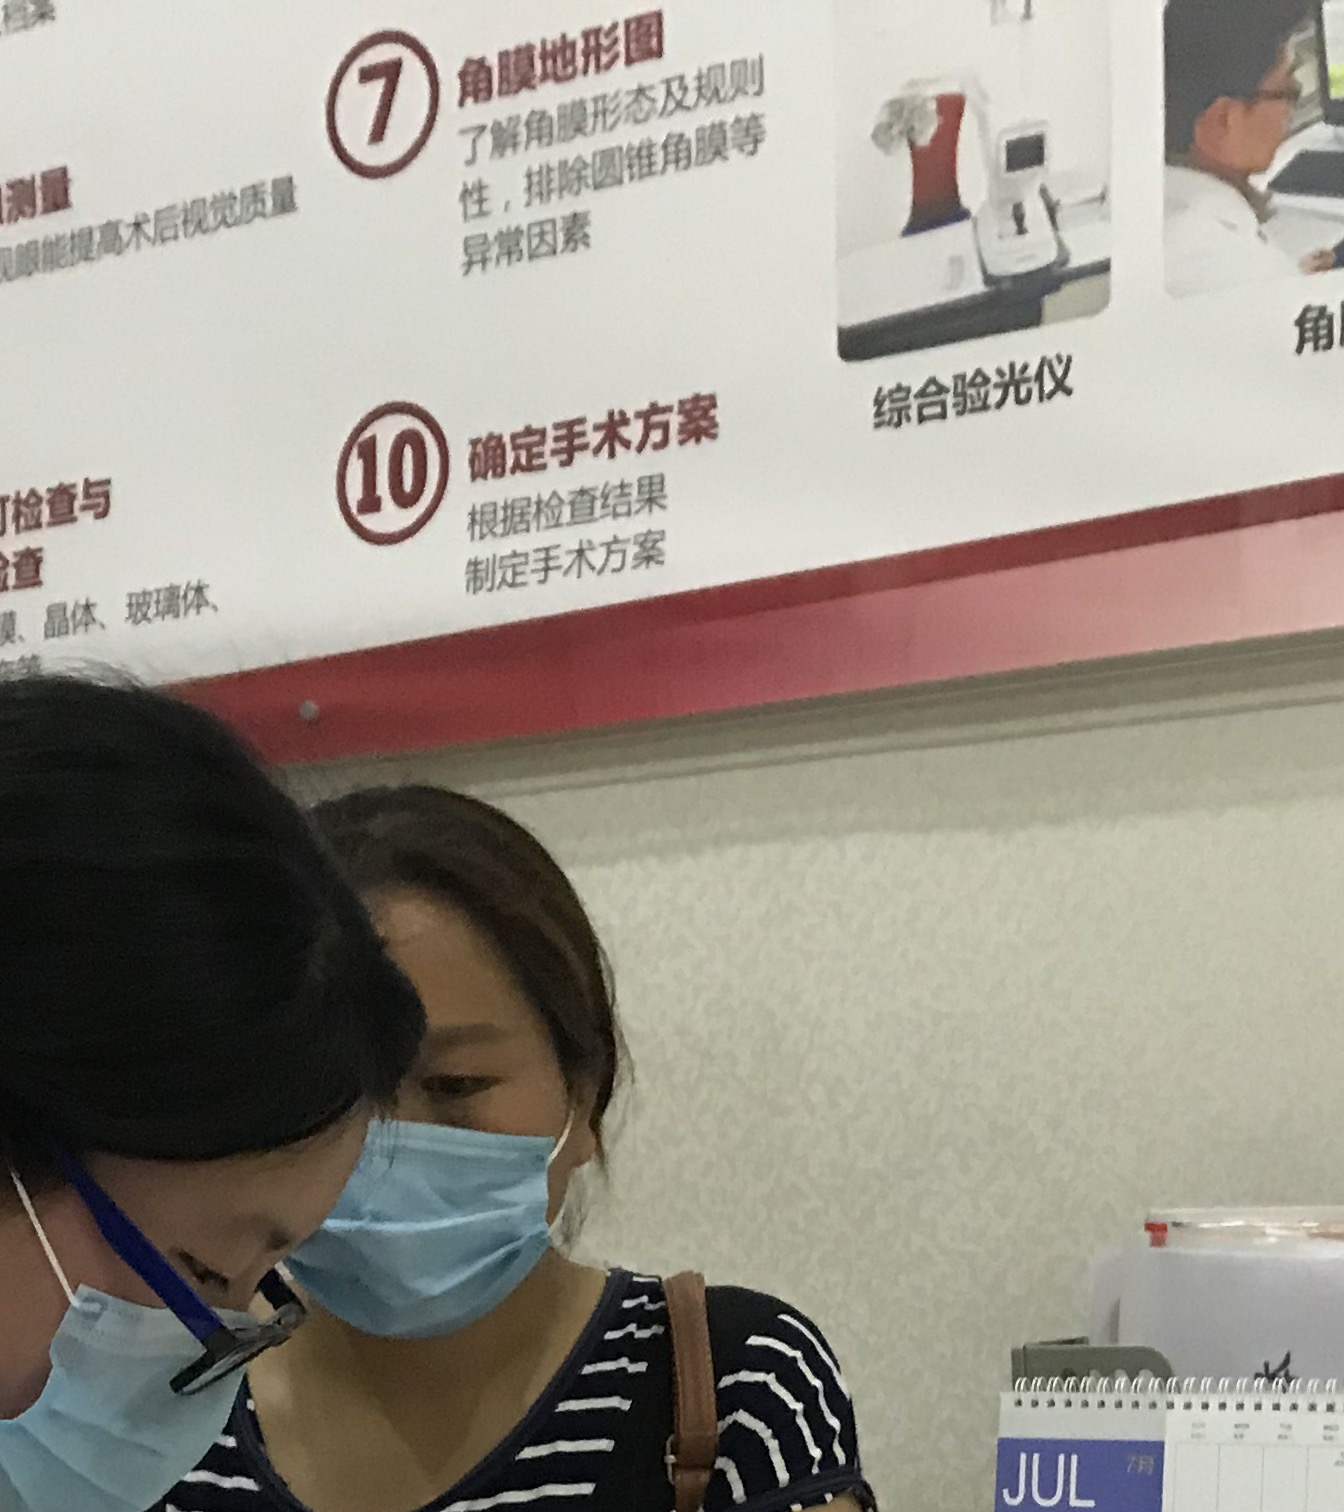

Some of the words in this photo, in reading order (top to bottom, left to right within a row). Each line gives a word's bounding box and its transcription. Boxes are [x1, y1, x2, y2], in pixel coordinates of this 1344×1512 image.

[457, 9, 665, 107] 角膜地形图
[358, 57, 403, 146] 7
[457, 53, 765, 168] 了解角膜形态及规则
[461, 210, 592, 277] 异常因素
[871, 353, 1075, 431] 综合验光仪
[355, 428, 428, 515] 10
[467, 393, 721, 482] 确定手术方案
[467, 472, 669, 541] 根据检查结果
[464, 529, 667, 595] 制定手术方案
[1002, 1452, 1096, 1507] JUL
